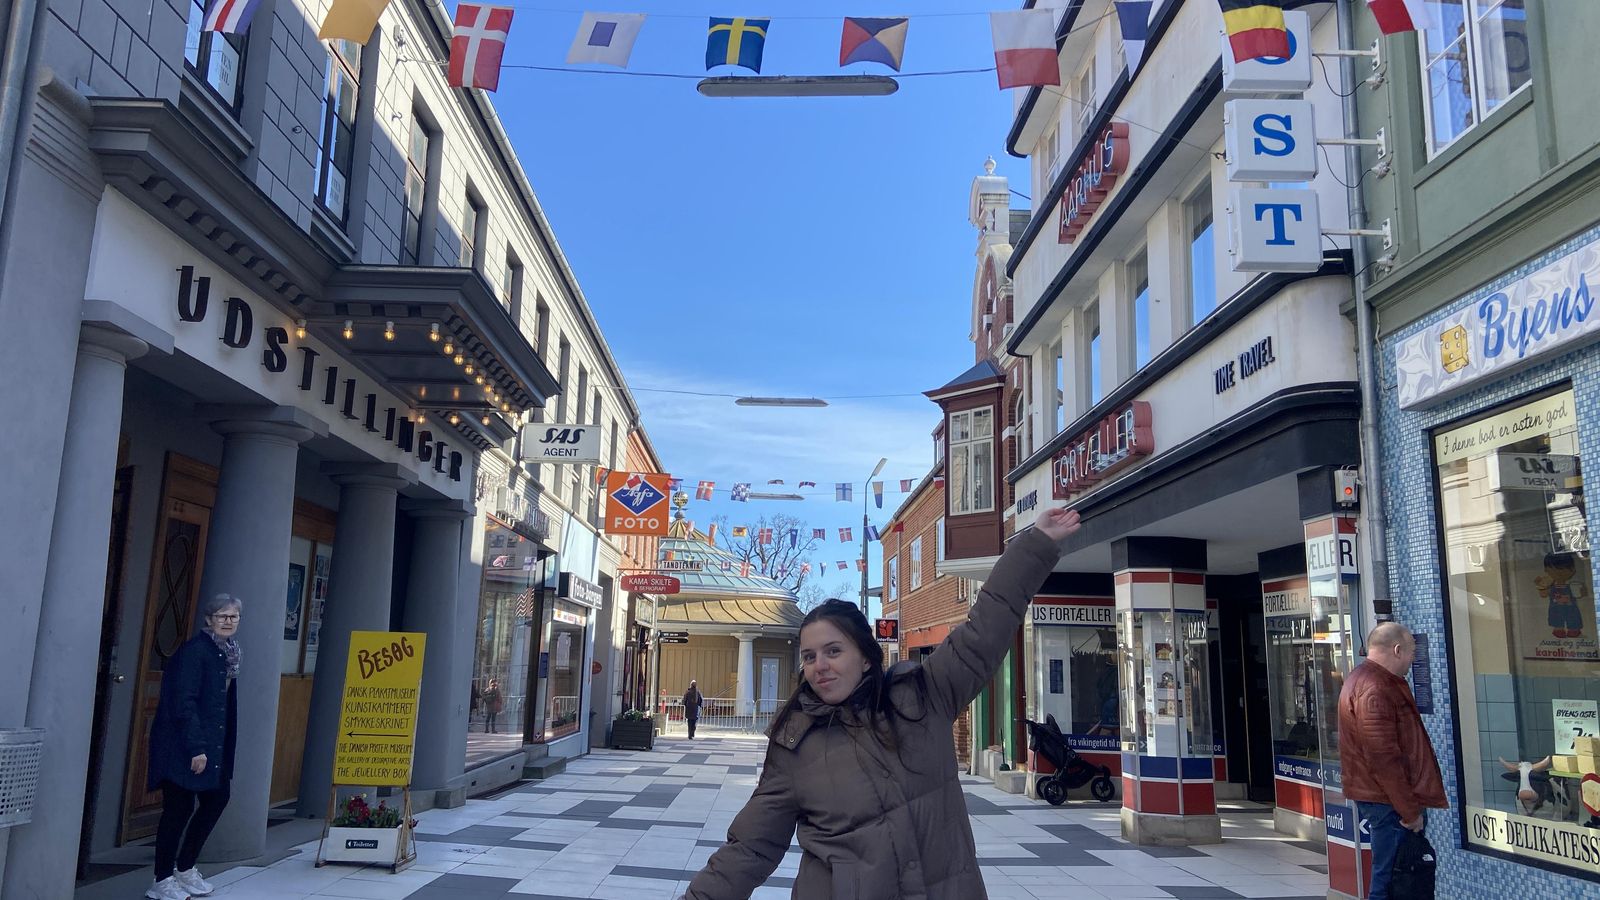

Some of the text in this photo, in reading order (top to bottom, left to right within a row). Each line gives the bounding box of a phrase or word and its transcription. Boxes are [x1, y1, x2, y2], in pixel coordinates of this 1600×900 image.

[1059, 127, 1118, 238] AARHUS
[1479, 273, 1595, 358] Byens
[1213, 336, 1276, 395] TIME TRAVEL
[176, 265, 463, 482] UDSTILLINGER
[1452, 437, 1475, 453] denne
[1479, 422, 1496, 443] bod
[1500, 426, 1509, 436] er
[1512, 413, 1543, 433] osten
[1546, 400, 1568, 428] god
[539, 428, 585, 444] SAS
[543, 448, 579, 457] AGENT
[614, 518, 659, 529] FOTO
[1265, 592, 1299, 613] FORTÆLLER
[1049, 607, 1111, 622] FORTÆLLER
[357, 636, 414, 679] BESØG
[1536, 648, 1598, 658] karolinemad
[347, 686, 416, 699] DANSK PLAKATMUSEUM
[345, 702, 414, 715] KUNSTKAMMERET
[1556, 710, 1597, 719] BYENS OSTE
[344, 716, 409, 729] SMYKKESKRINET
[339, 743, 347, 752] THE
[349, 743, 368, 753] DANISH
[369, 743, 389, 753] POSTER
[1078, 737, 1107, 749] vikingetid
[337, 767, 408, 778] THE JEWELLERY BOX
[1327, 813, 1344, 831] nutid
[1473, 813, 1600, 866] OST DELIKATESS
